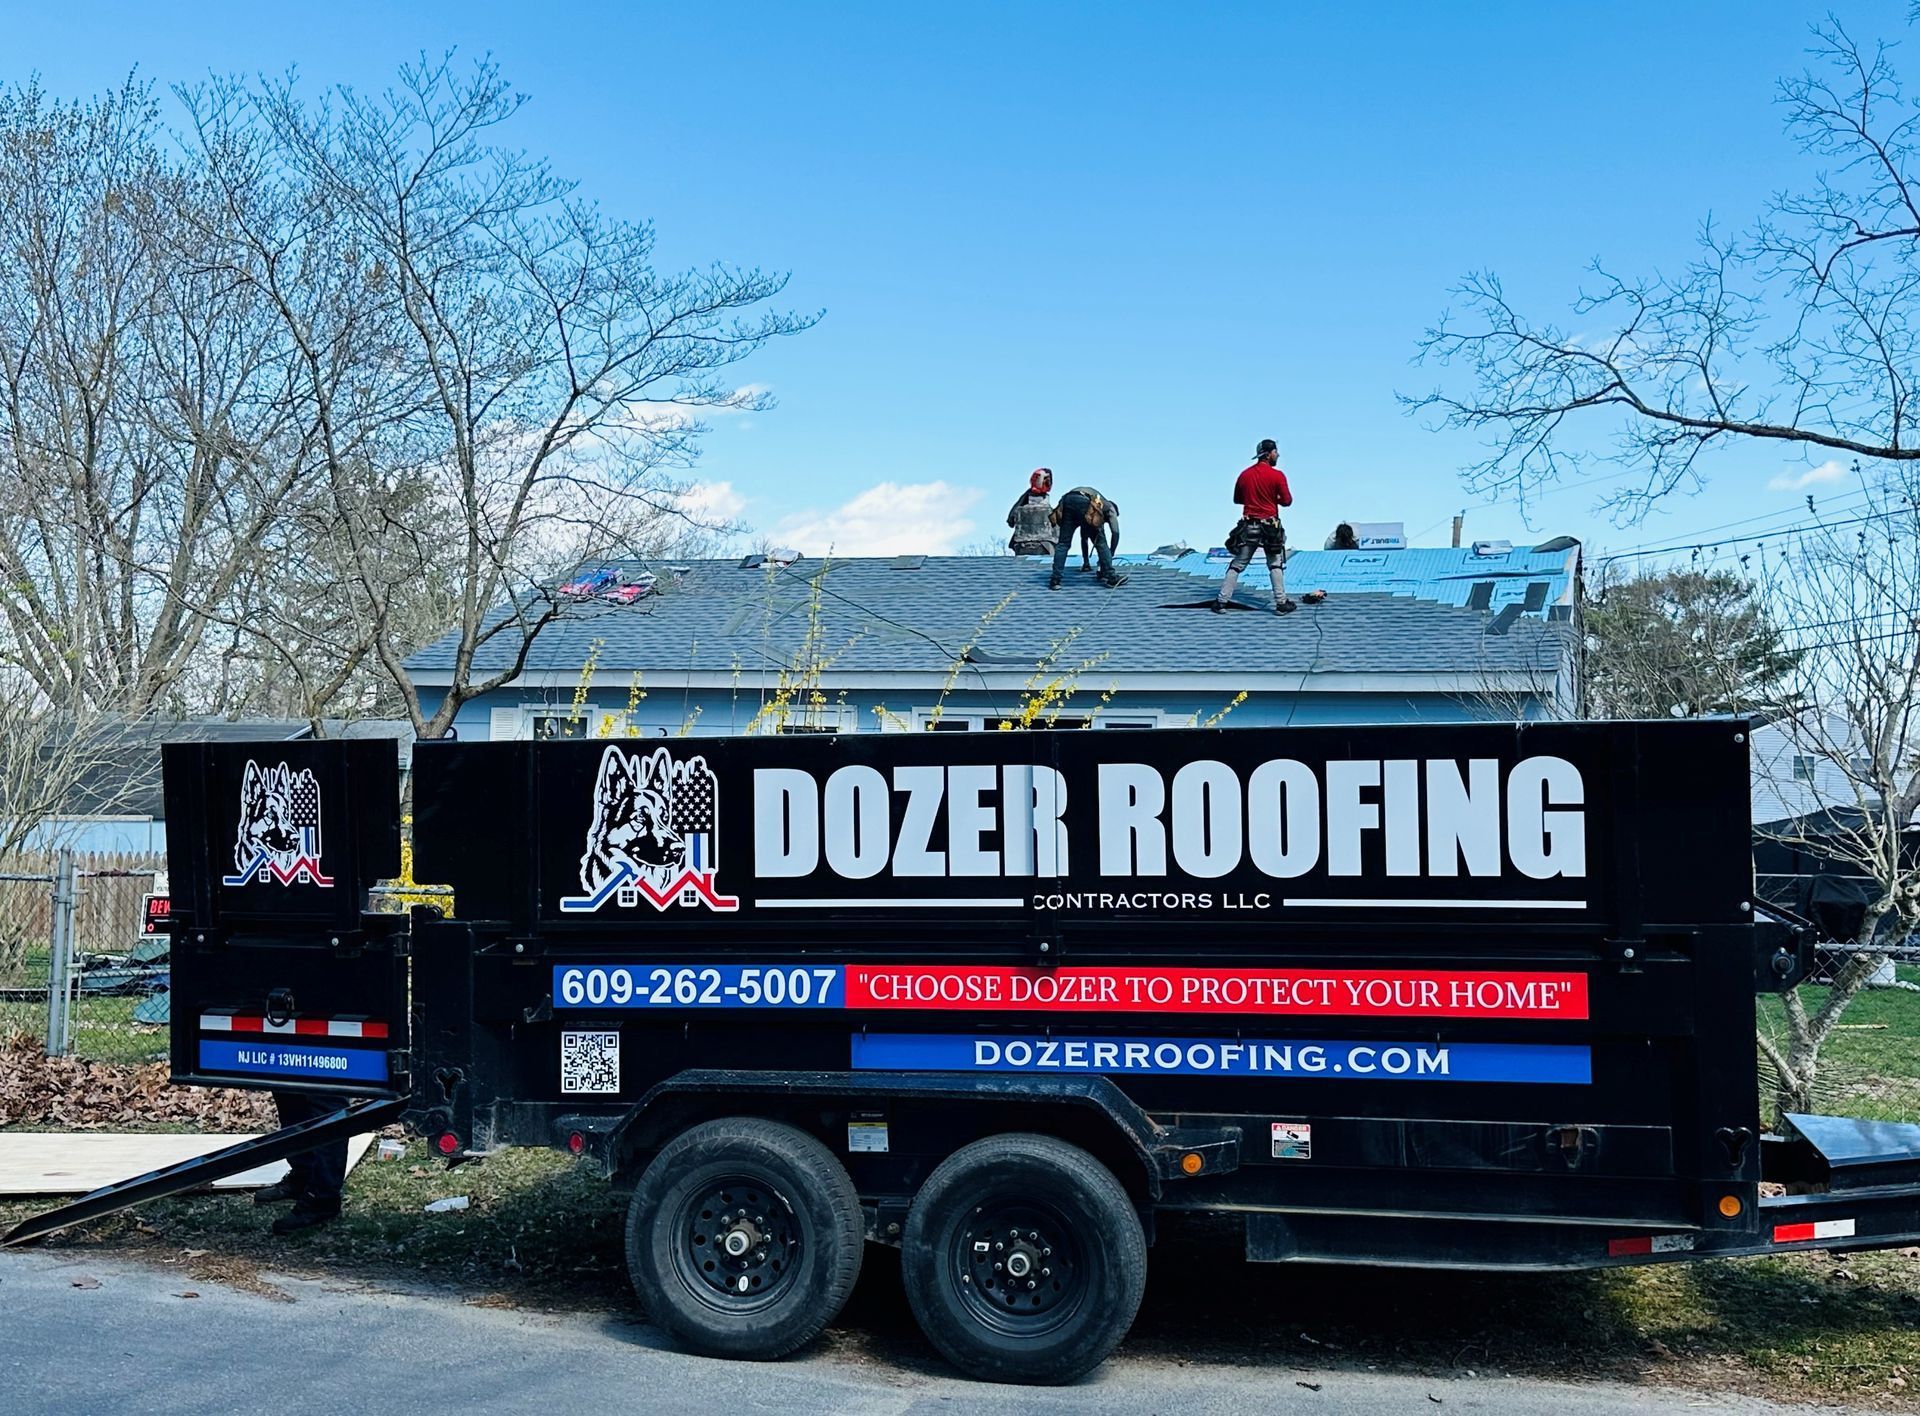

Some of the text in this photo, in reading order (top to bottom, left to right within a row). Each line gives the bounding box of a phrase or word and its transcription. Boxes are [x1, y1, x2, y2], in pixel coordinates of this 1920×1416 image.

[754, 755, 1587, 880] DOZER ROOFING
[1032, 892, 1271, 911] CONTRACTORS LLC
[562, 968, 837, 1005] 609-262-5007
[859, 973, 1572, 1009] "CHOOSE DOZER TO PROTECT YOUR HOME"
[238, 1050, 250, 1064] NJ
[252, 1052, 267, 1065] LIC
[278, 1053, 348, 1070] 13VH11496800
[974, 1041, 1450, 1075] DOZERROOFING.COM
